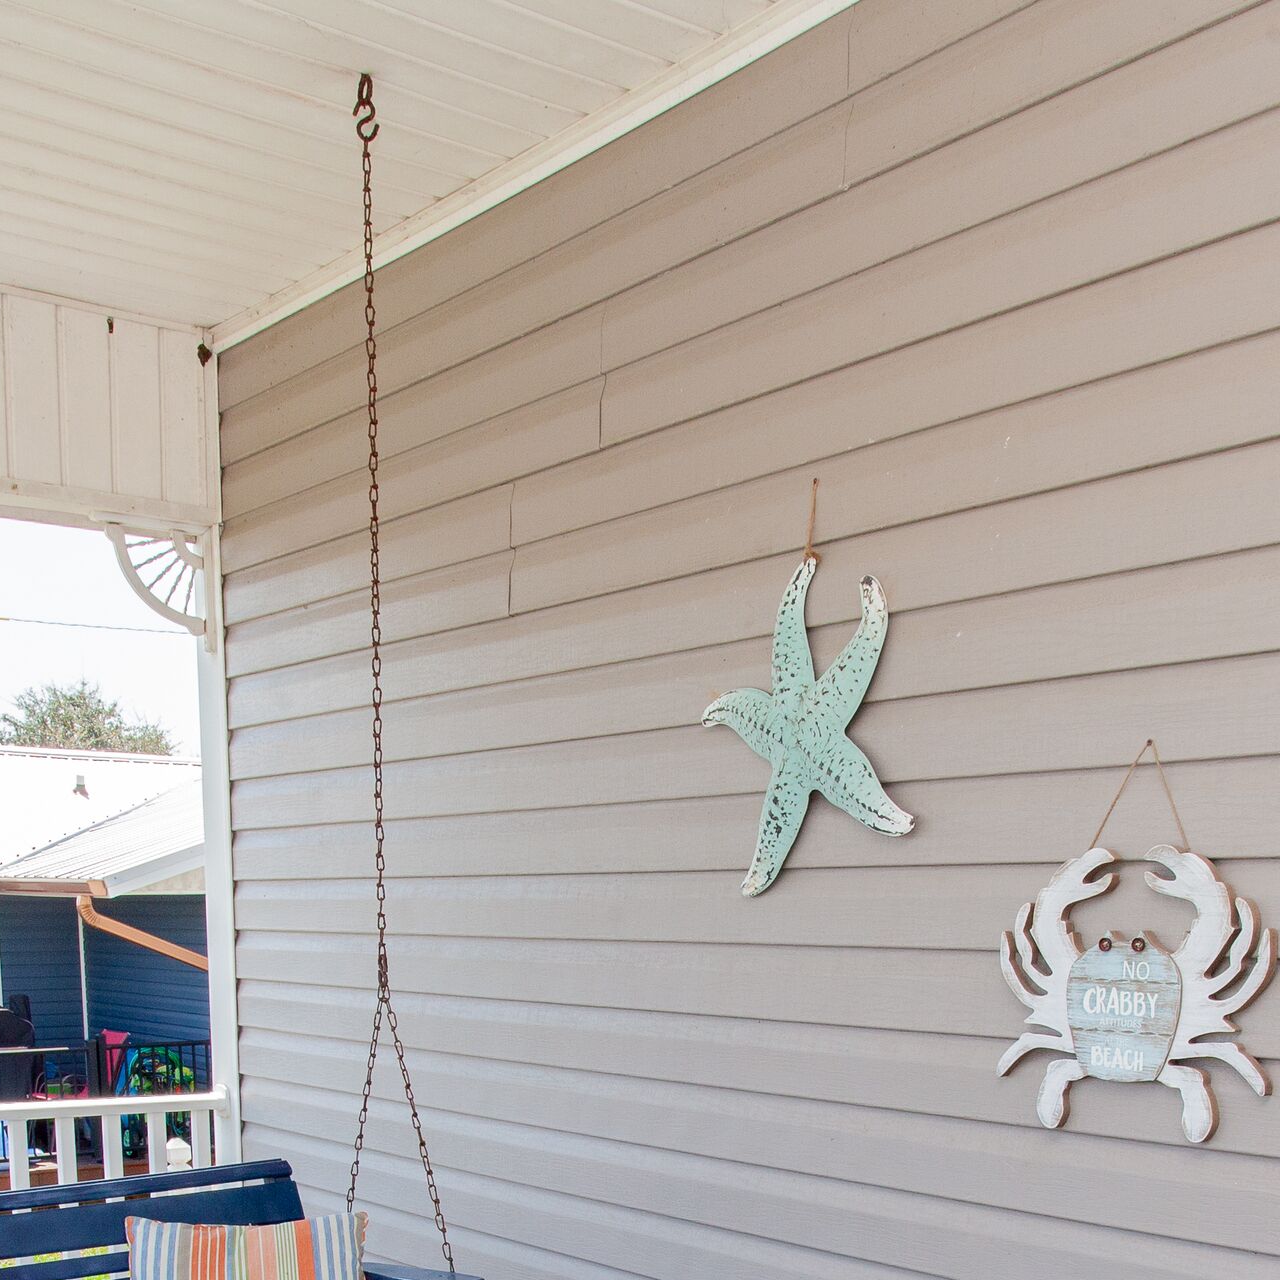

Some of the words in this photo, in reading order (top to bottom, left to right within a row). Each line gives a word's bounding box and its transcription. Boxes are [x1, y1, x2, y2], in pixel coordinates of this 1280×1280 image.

[1122, 961, 1150, 980] NO
[1083, 986, 1158, 1019] CRABBY
[1090, 1046, 1144, 1072] BEACH
